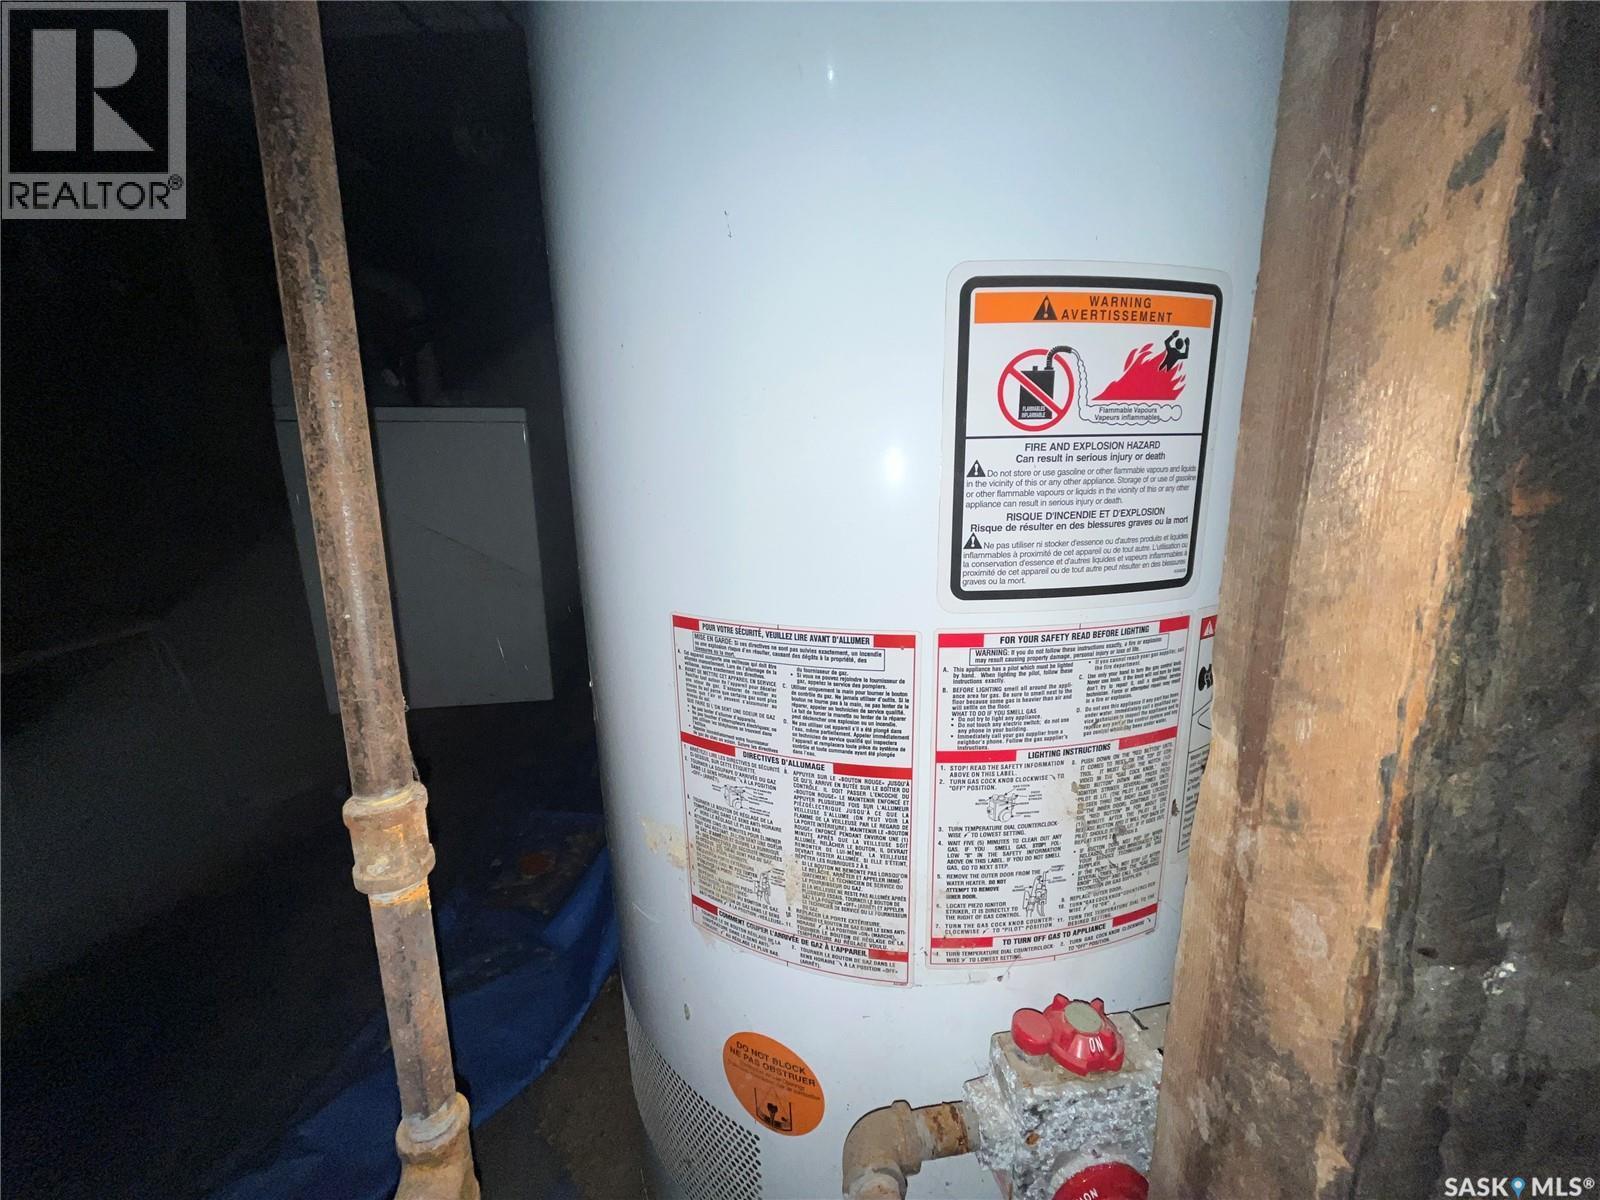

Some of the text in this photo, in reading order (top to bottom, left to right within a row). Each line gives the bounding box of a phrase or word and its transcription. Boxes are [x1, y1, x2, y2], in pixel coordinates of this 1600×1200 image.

[1090, 296, 1152, 308] WARNING
[1061, 309, 1172, 322] AVERTISSEMENT
[1134, 406, 1157, 414] Vapours
[1025, 441, 1160, 451] FIRE AND EXPLOSION HAZARD
[1016, 455, 1034, 463] Can
[1037, 454, 1063, 462] result
[1065, 454, 1073, 462] in
[1076, 453, 1107, 461] serious
[1110, 453, 1132, 462] injury
[1146, 452, 1165, 460] death
[1057, 468, 1085, 477] gasoline
[1096, 467, 1112, 475] other
[989, 479, 1013, 488] vicinity
[1048, 479, 1061, 487] any
[1118, 476, 1141, 484] Storage
[1076, 487, 1096, 495] liquids
[1118, 486, 1138, 494] vicinity
[966, 501, 1000, 509] appliance
[1076, 498, 1093, 506] injury
[1007, 507, 1165, 521] RISQUE D'INCENDIE ET D'EXPLOSION
[971, 524, 1002, 533] Risque
[1020, 522, 1054, 531] résulter
[1088, 520, 1125, 528] blessures
[1128, 519, 1152, 528] graves
[996, 542, 1009, 550] pas
[962, 578, 986, 586] graves
[702, 623, 715, 632] POUR
[717, 624, 733, 634] VOTRE
[766, 632, 792, 640] VEUILLEZ
[794, 633, 808, 641] LIRE
[810, 635, 830, 643] AVANT
[832, 636, 870, 645] D'ALLUMER
[1000, 625, 1149, 644] FOR YOUR SAFETY READ BEFORE LIGHTING
[1028, 744, 1111, 759] LIGHTING INSTRUCTIONS
[743, 752, 825, 771] DIRECTIVES D'ALLUMAGE
[1024, 760, 1064, 768] INFORMATION
[719, 911, 745, 925] COMMENT
[747, 920, 768, 933] COUPER
[831, 946, 867, 957] L'APPAREIL
[1002, 938, 1012, 946] TO
[1014, 937, 1032, 945] TURN
[1034, 935, 1046, 943] OFF
[1048, 933, 1061, 941] GAS
[1073, 923, 1106, 937] APPLIANCE
[1089, 1036, 1104, 1053] ON
[736, 1041, 805, 1075] DO NOT BLOCK
[730, 1047, 816, 1086] NE PAS OBSTRUER
